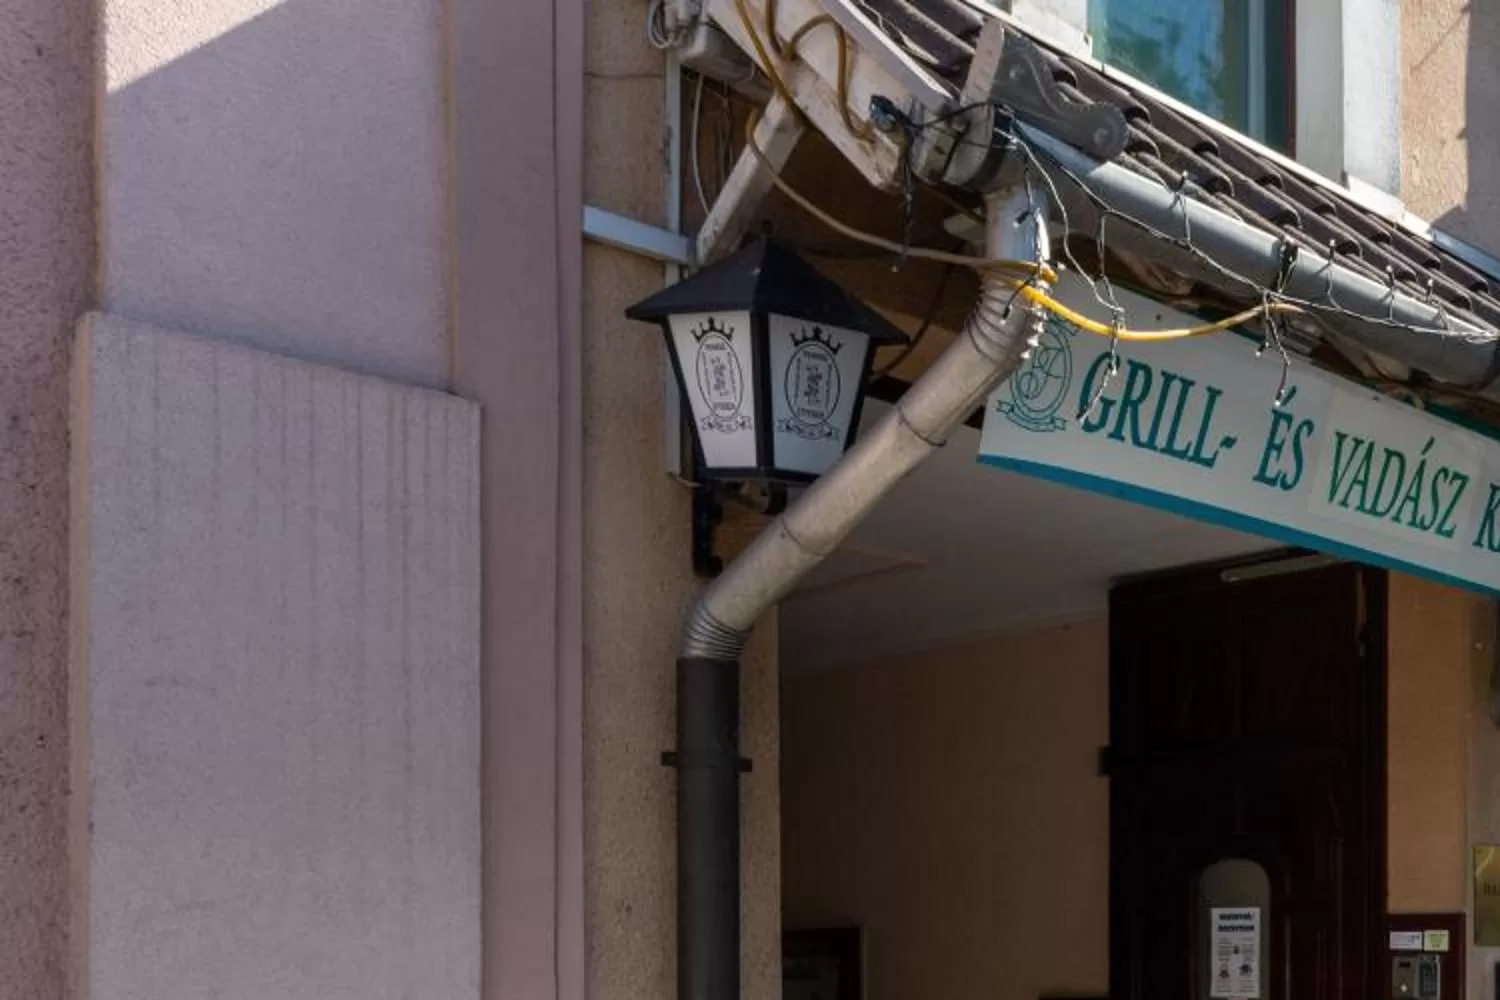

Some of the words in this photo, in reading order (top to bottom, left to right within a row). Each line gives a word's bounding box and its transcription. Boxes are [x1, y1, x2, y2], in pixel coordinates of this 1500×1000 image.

[1078, 351, 1238, 469] GRILL-
[1252, 385, 1315, 492] ÉS
[1327, 436, 1470, 540] VADÁSZ
